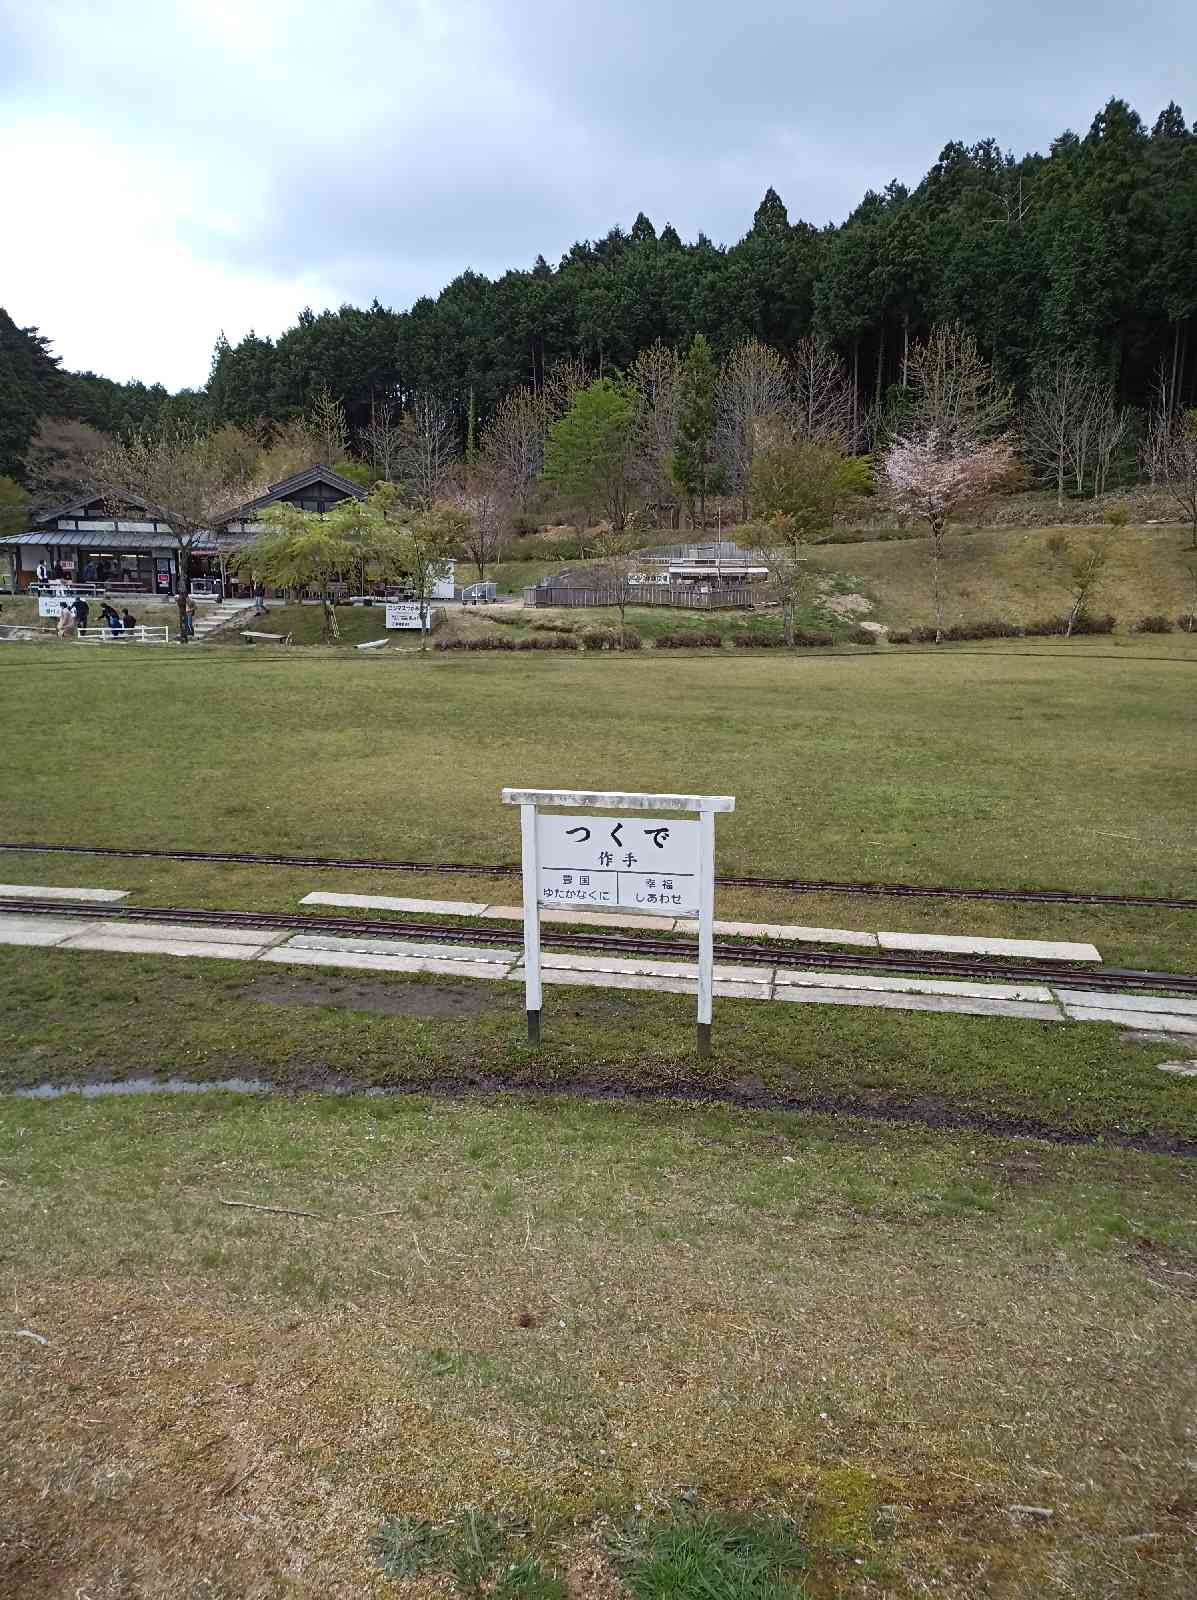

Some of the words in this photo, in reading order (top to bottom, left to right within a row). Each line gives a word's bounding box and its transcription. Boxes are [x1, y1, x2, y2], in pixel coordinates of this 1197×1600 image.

[565, 822, 670, 849] つくで
[598, 851, 638, 868] 作手
[645, 878, 674, 890] 幸福
[543, 887, 611, 902] ゆたかなくに
[635, 893, 683, 905] しあわせ
